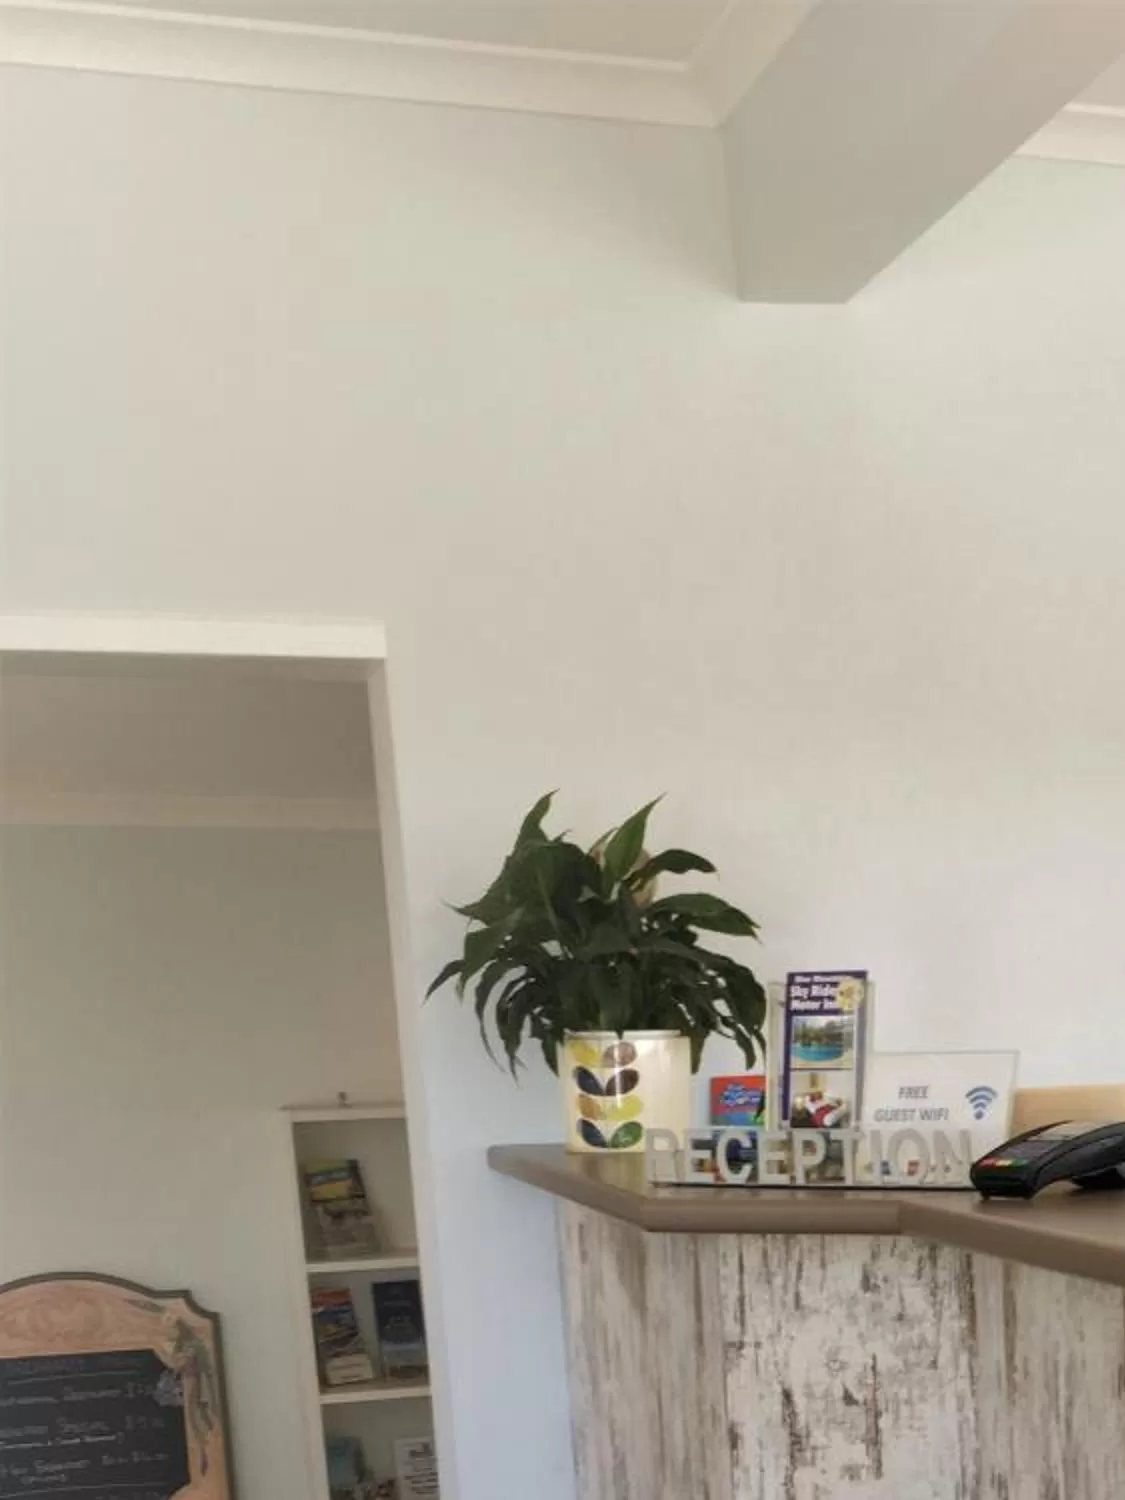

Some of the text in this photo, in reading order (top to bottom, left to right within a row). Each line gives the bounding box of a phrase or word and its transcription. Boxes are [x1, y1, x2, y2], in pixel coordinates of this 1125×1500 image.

[811, 984, 838, 997] Ride
[897, 1085, 929, 1100] FREE
[873, 1106, 949, 1123] GUEST WIFI
[645, 1127, 975, 1187] RECEPTION
